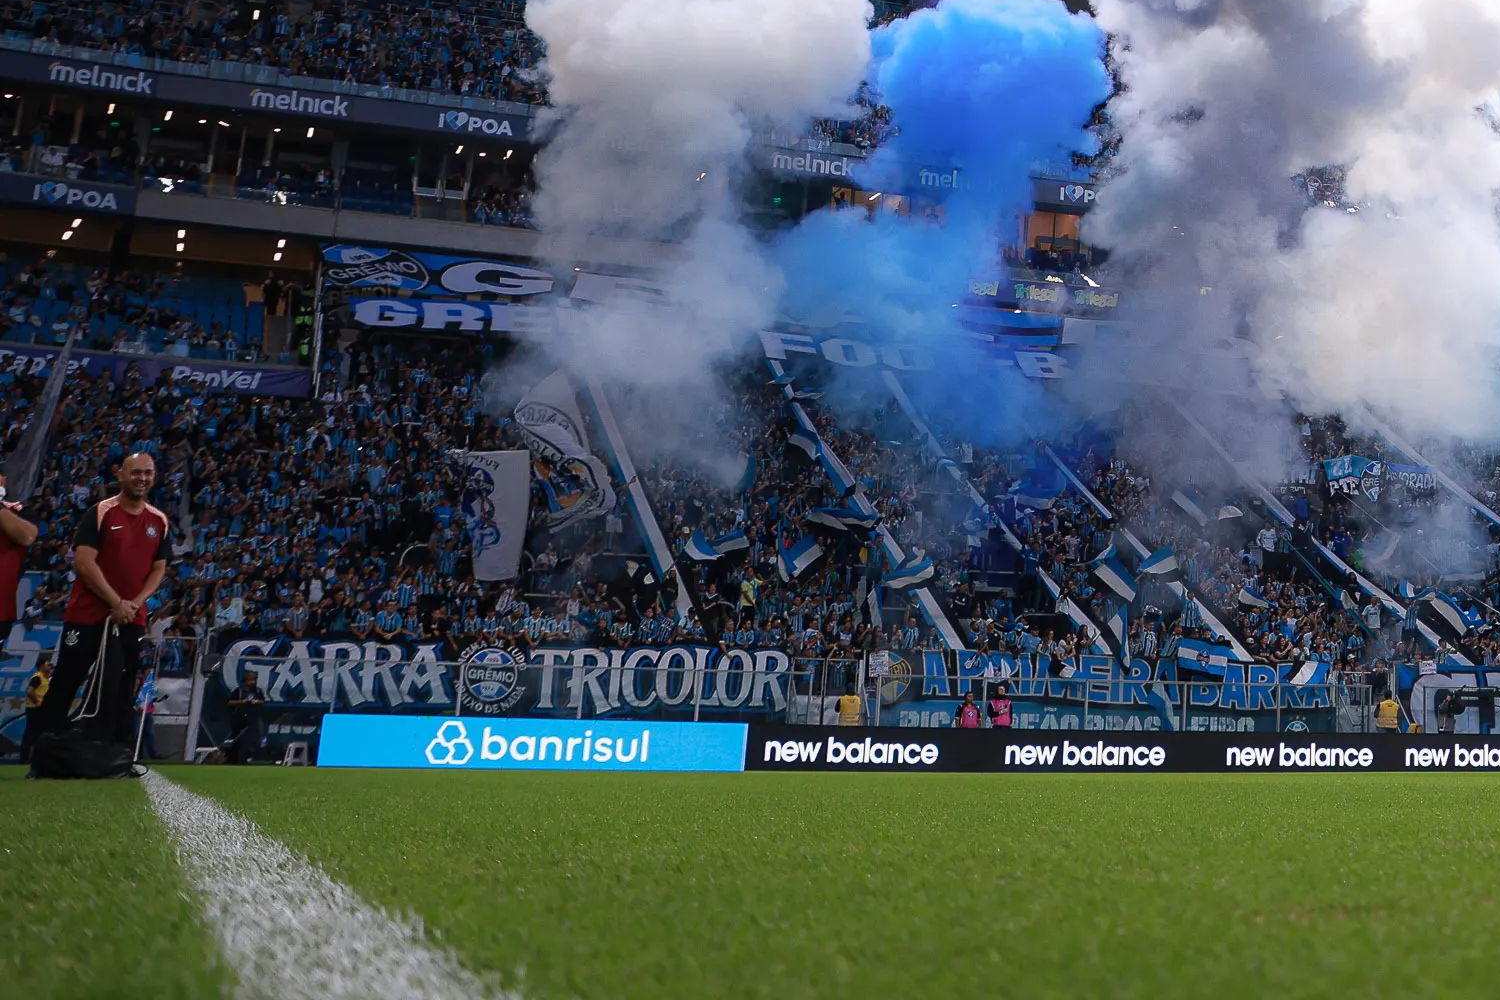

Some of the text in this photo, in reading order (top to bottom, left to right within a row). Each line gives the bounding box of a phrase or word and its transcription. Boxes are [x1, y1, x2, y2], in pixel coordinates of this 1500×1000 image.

[49, 62, 154, 94] melnick
[250, 89, 348, 118] melnick
[468, 117, 512, 136] POA
[771, 151, 854, 177] melnick
[66, 187, 117, 210] POA
[328, 261, 418, 280] GRÊMIO
[171, 366, 263, 390] PanVel
[220, 638, 452, 704] GARRA
[468, 668, 514, 683] GRÊMIO
[528, 646, 792, 714] TRICOLOR
[481, 729, 650, 764] banrisul
[764, 737, 939, 765] new balance
[1005, 740, 1166, 767] new balance
[1226, 743, 1373, 768] new balance
[1405, 746, 1450, 767] new
